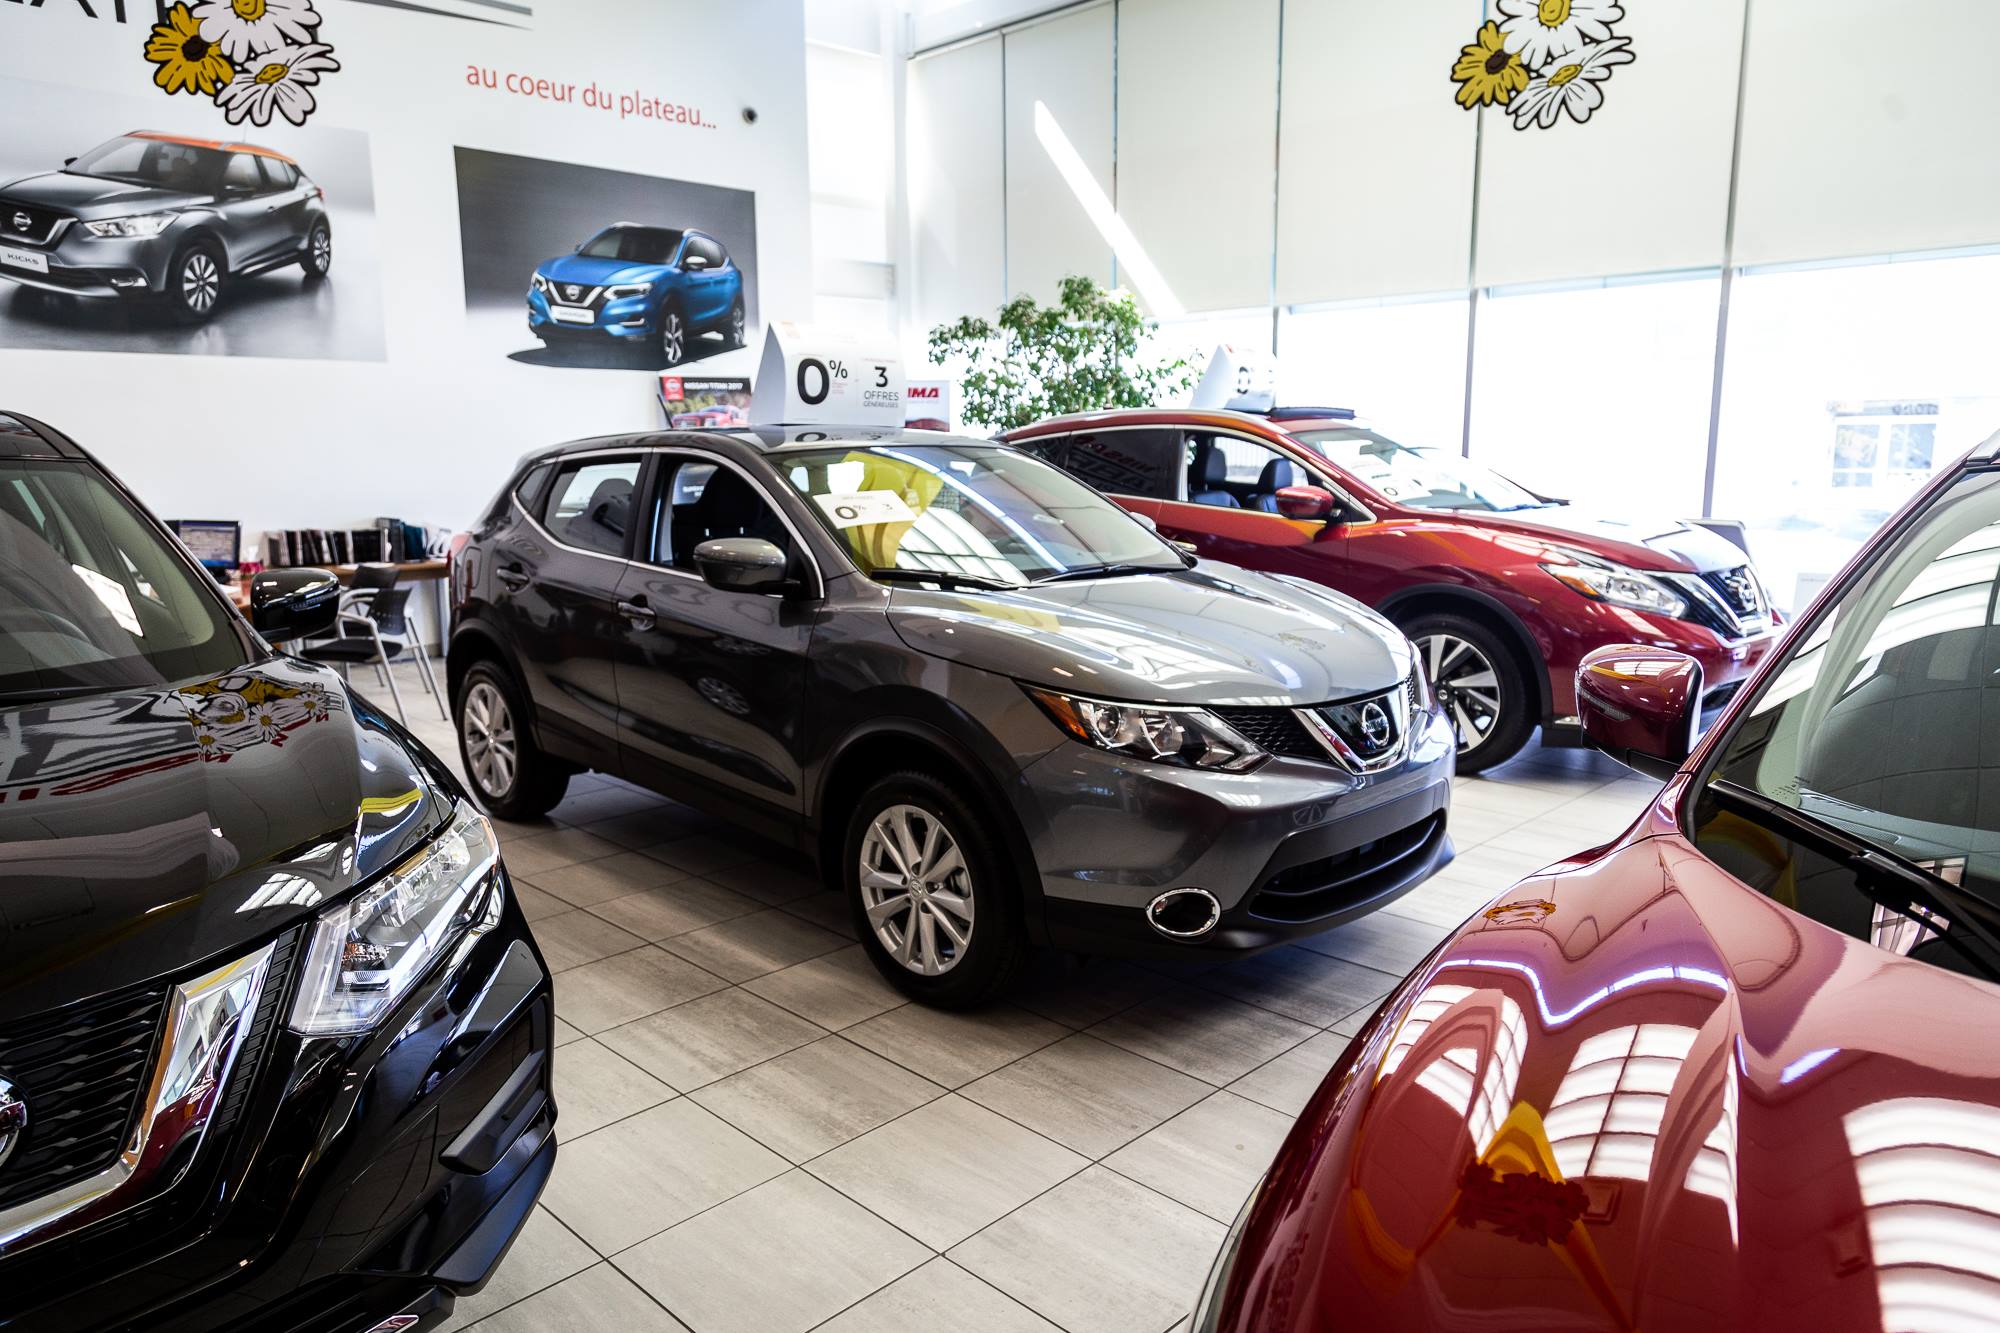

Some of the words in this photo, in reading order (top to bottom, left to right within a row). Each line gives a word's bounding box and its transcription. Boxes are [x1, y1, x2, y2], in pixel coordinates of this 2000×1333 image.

[466, 65, 497, 89] au
[505, 73, 576, 103] coeur
[582, 82, 612, 110] du
[619, 90, 717, 129] plateau...
[7, 253, 39, 265] KICKS
[874, 366, 888, 388] 3
[863, 390, 899, 401] OFFRES
